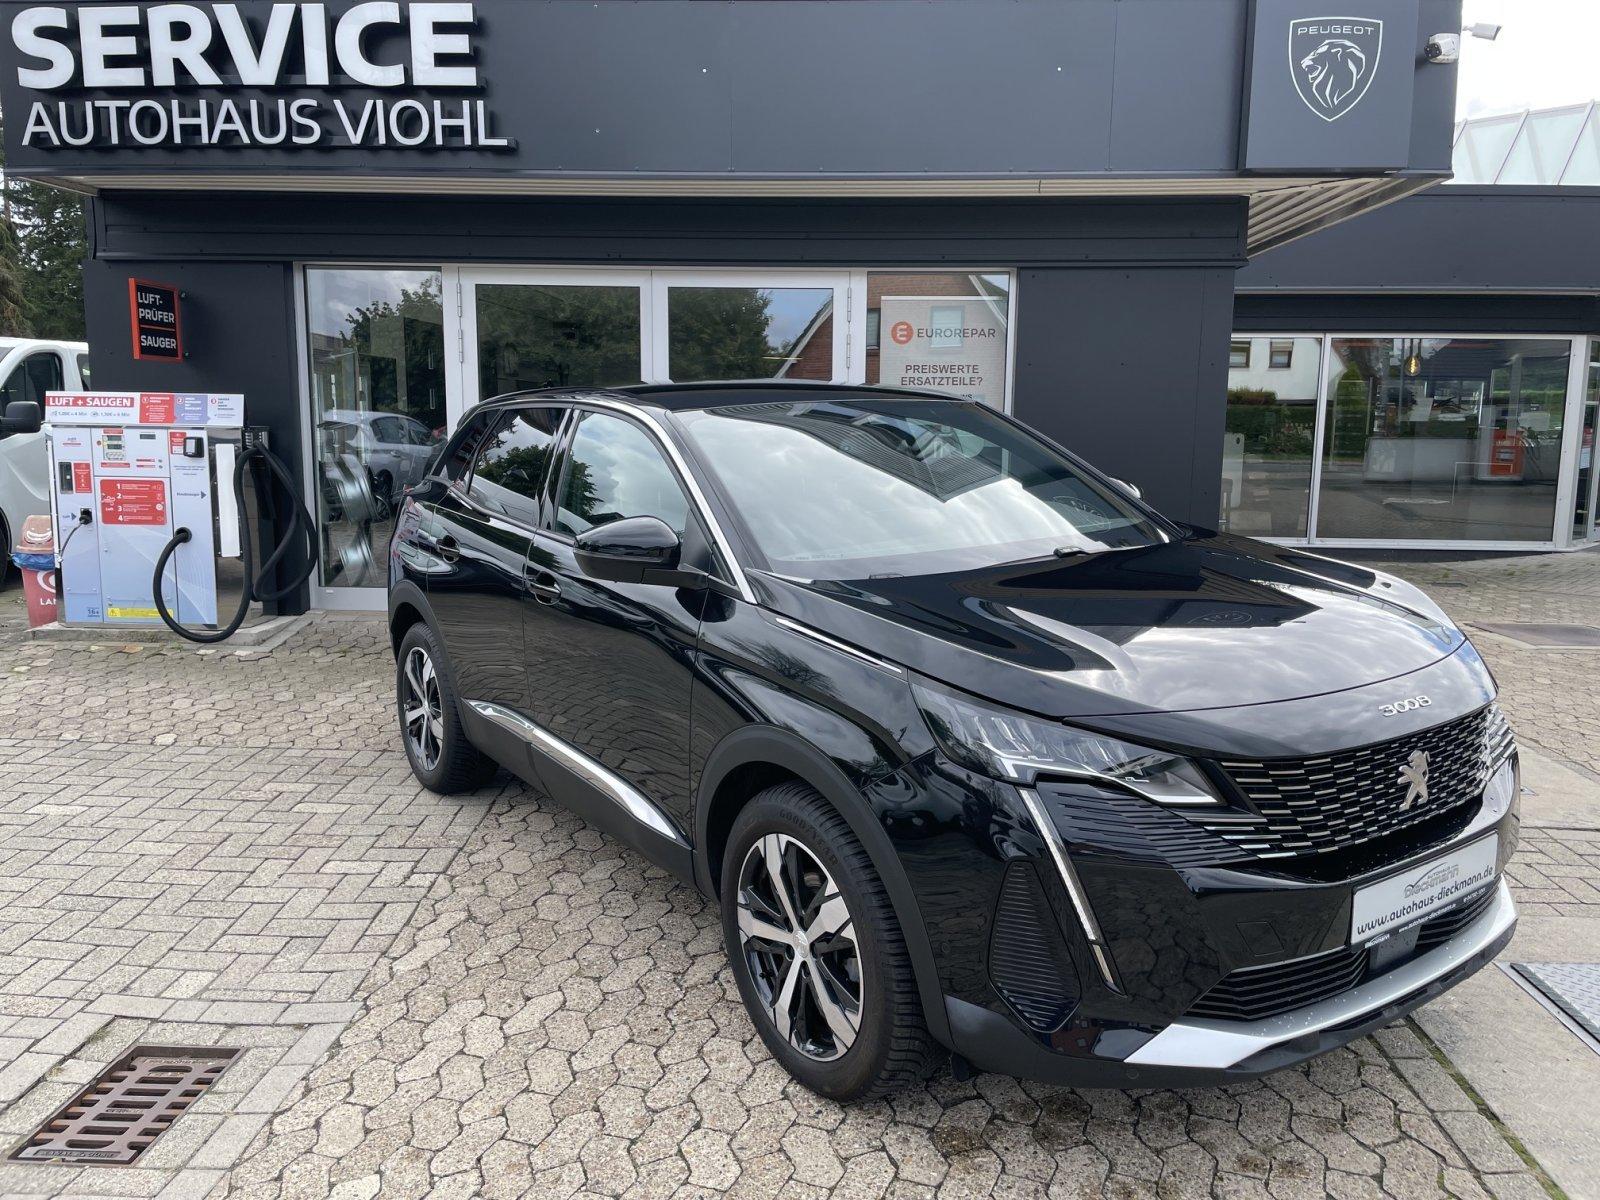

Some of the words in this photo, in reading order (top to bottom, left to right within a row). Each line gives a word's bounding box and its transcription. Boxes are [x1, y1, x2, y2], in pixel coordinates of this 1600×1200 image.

[1297, 25, 1374, 35] PEUGEOT
[11, 2, 478, 89] SERVICE
[22, 99, 321, 146] AUTOHAUS
[333, 99, 508, 146] VIOHL
[138, 291, 163, 305] LUFT-
[139, 307, 175, 323] PRÜFER
[917, 327, 996, 338] EUROREPAR
[141, 335, 177, 349] SAUGER
[905, 364, 979, 374] PREISWERTE
[900, 376, 983, 386] ERSATZTEILE?
[49, 397, 74, 406] LUFT
[86, 398, 131, 407] SAUGEN
[1379, 695, 1432, 717] 3008
[1357, 864, 1494, 935] www.autohaus-dieckmann.de
